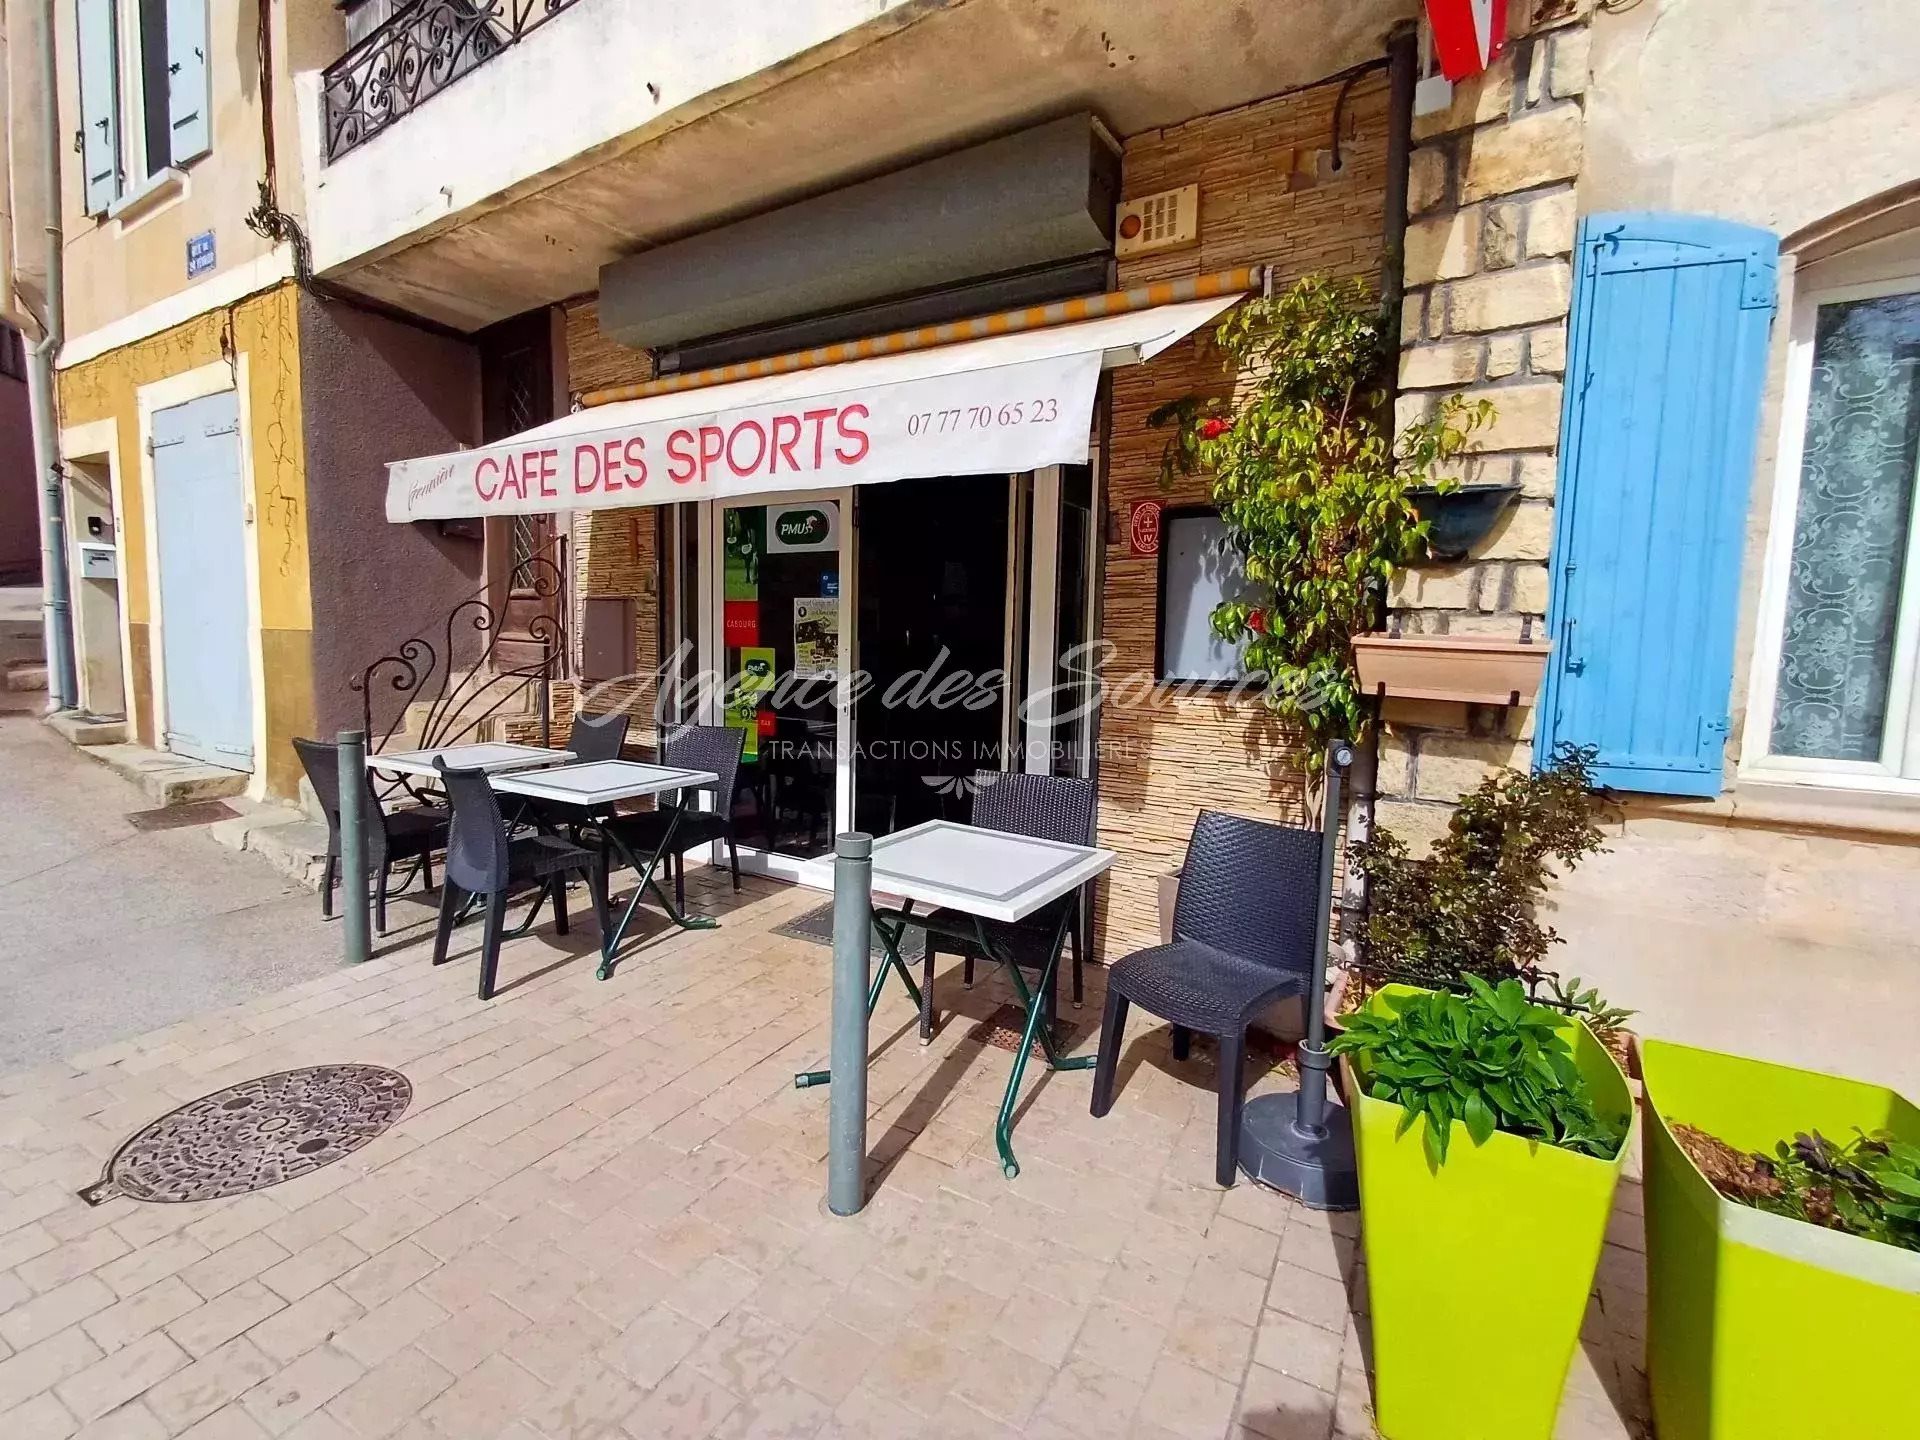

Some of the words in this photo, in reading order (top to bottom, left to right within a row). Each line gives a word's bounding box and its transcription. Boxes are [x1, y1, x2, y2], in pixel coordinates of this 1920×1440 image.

[907, 413, 932, 437] 07
[938, 408, 961, 434] 77
[968, 405, 992, 431] 70
[999, 401, 1024, 427] 65
[1031, 397, 1059, 424] 23
[475, 448, 558, 502] CAFE
[574, 436, 648, 494] DES
[666, 403, 870, 485] SPORTS
[781, 522, 806, 536] PMU
[726, 619, 757, 629] CABOURG
